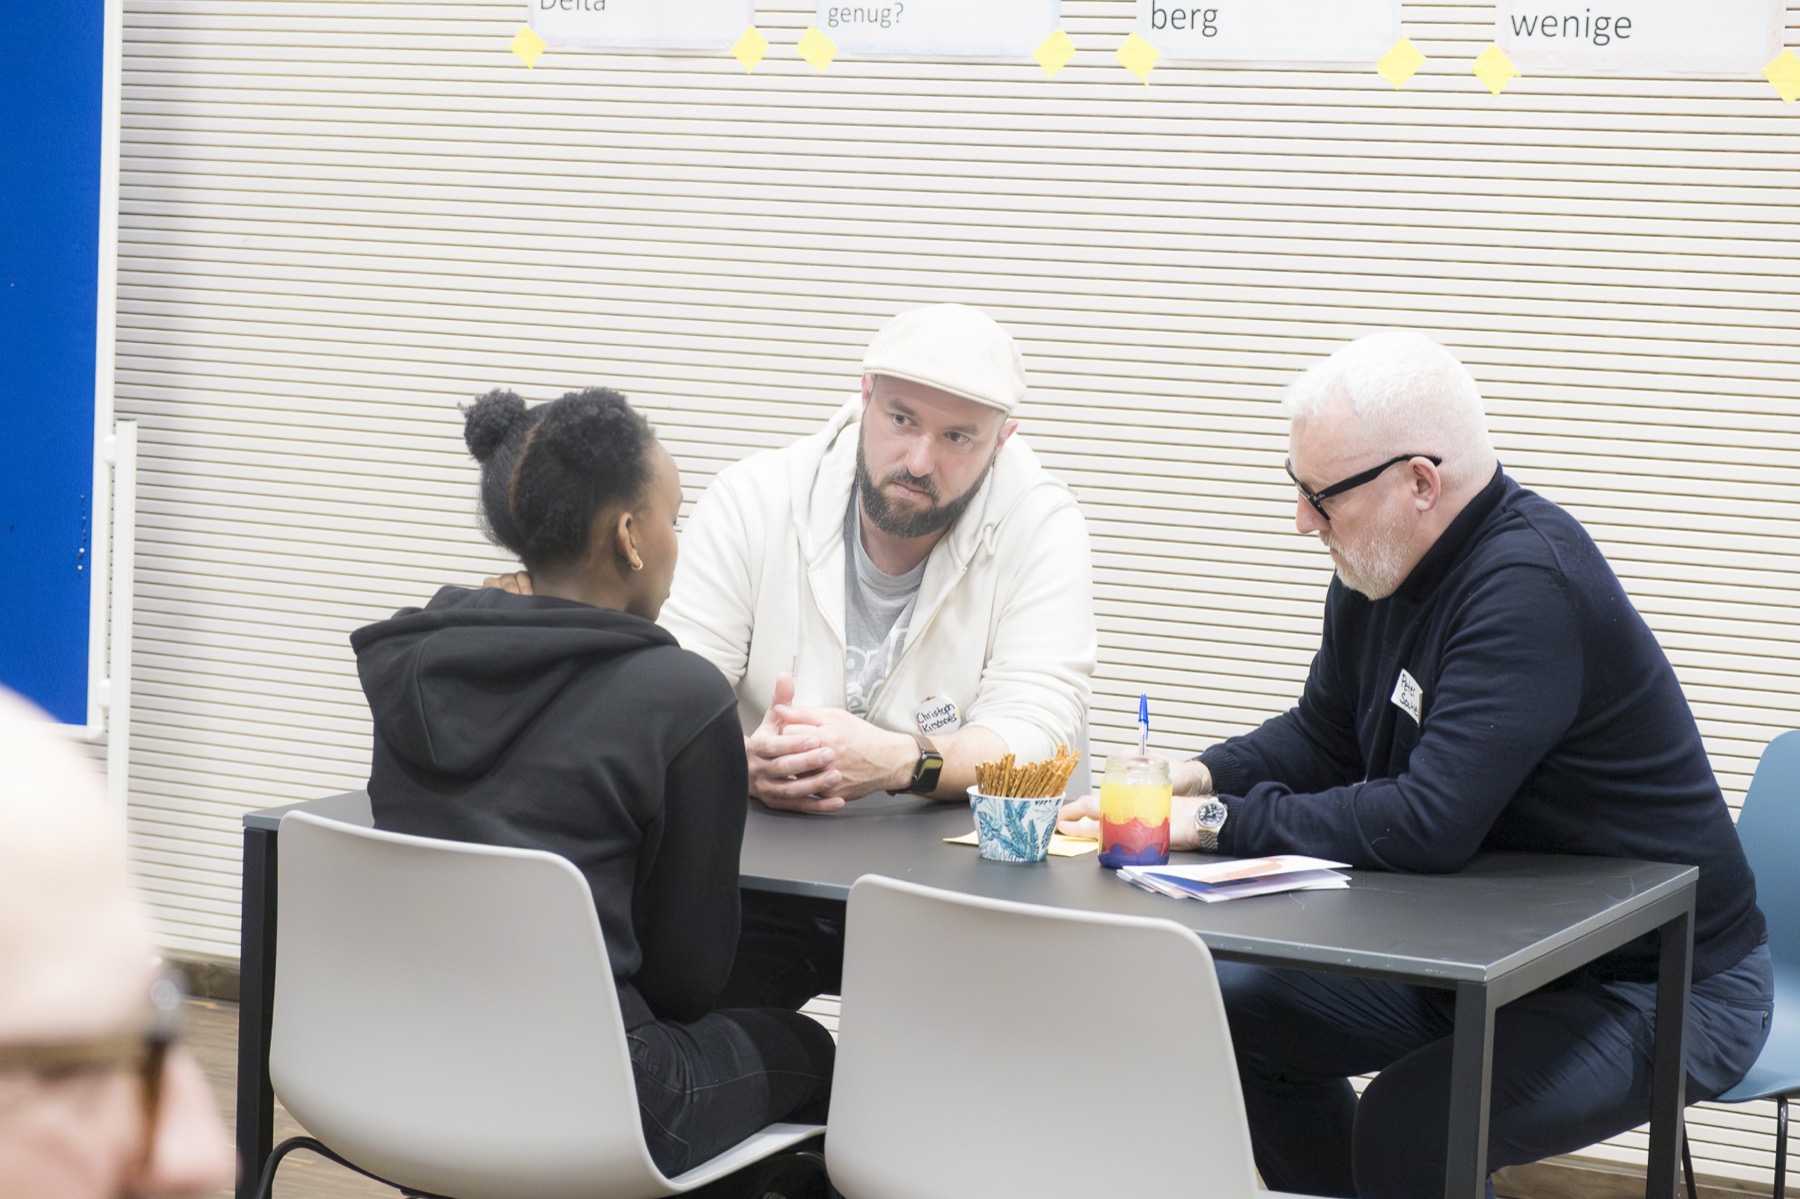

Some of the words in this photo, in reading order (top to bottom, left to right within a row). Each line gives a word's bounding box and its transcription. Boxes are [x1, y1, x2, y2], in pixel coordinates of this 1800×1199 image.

[828, 2, 904, 28] genug?
[1152, 0, 1219, 37] berg
[1511, 8, 1632, 46] wenige
